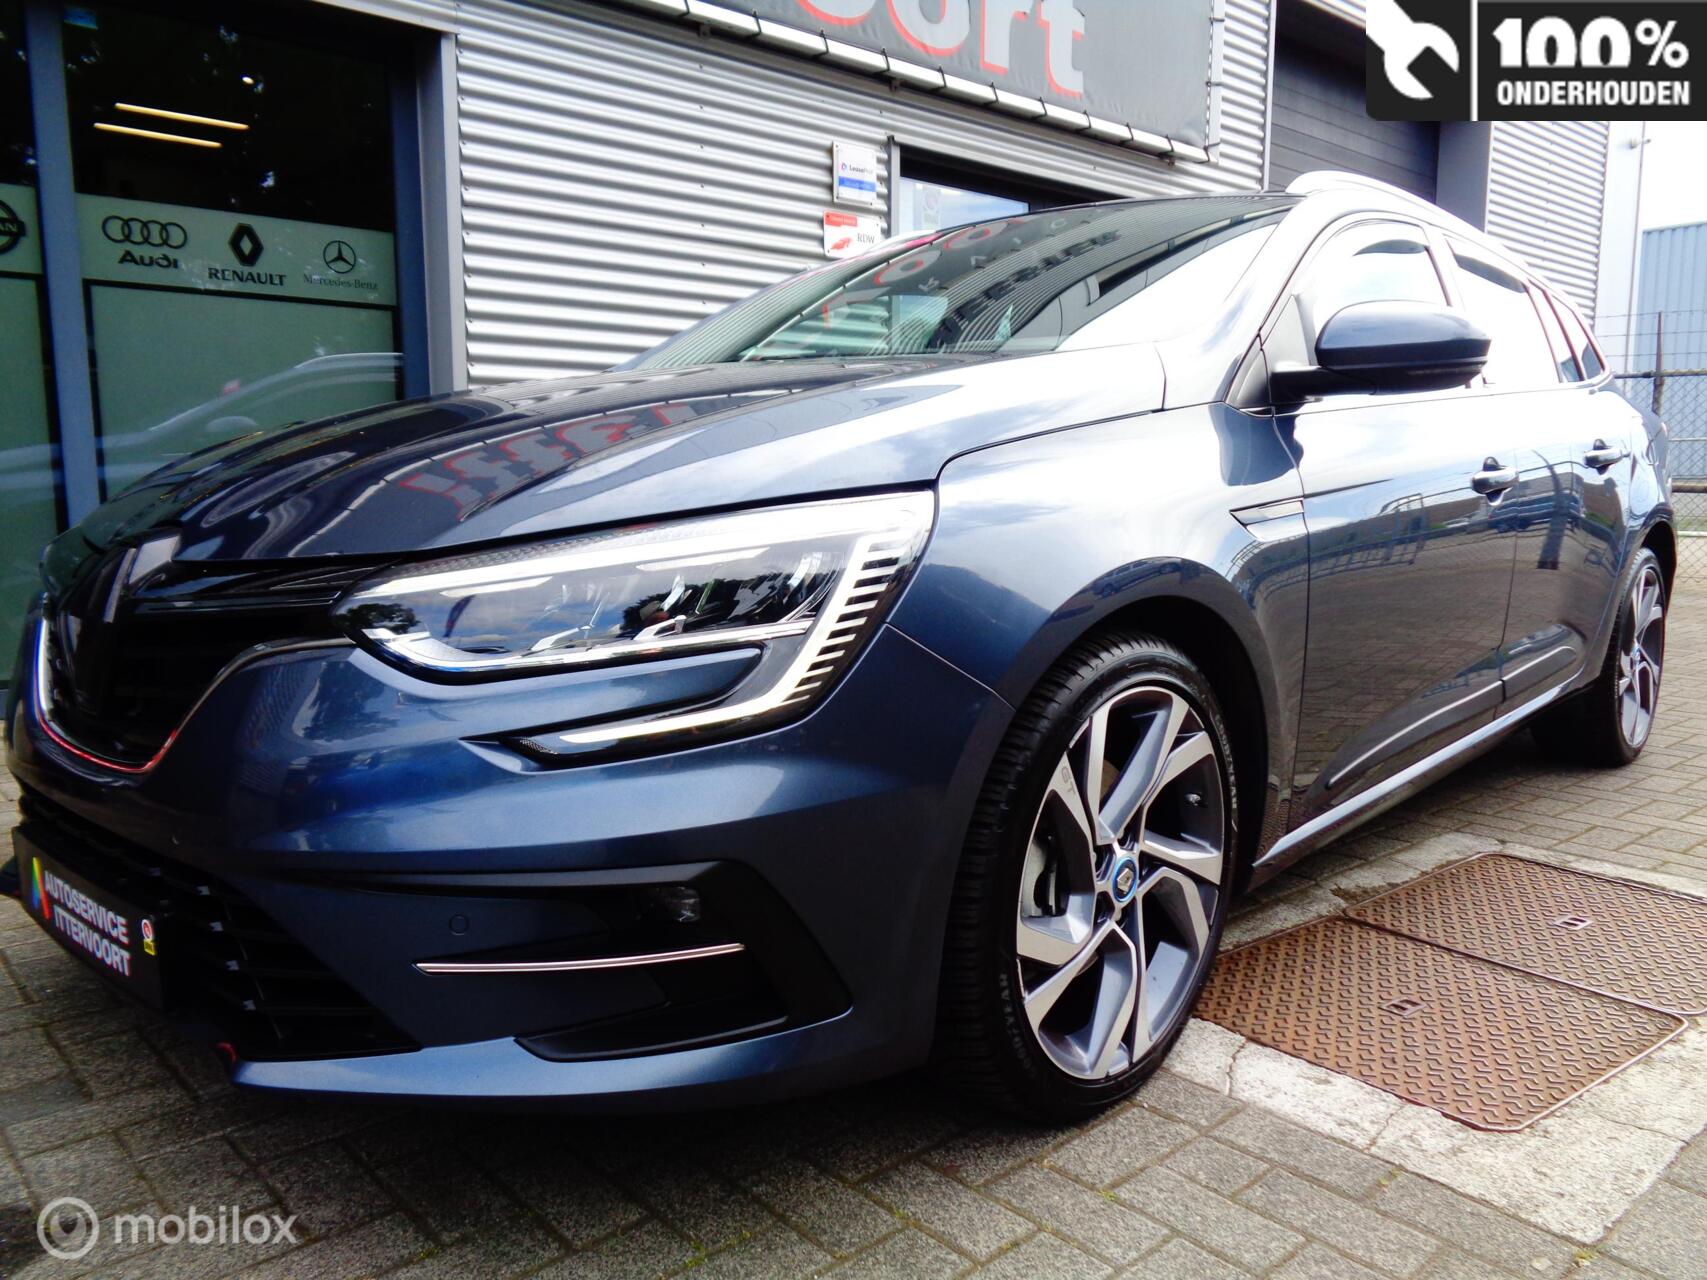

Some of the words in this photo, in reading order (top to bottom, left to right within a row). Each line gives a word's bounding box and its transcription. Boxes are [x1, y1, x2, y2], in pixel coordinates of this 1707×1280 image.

[857, 232, 875, 244] RDW
[118, 249, 178, 269] Audi
[207, 267, 287, 287] RENAULT
[303, 273, 379, 290] Mercedes-Benz
[44, 870, 129, 945] AUTOSERVICE
[53, 904, 131, 977] ITTERVOORT
